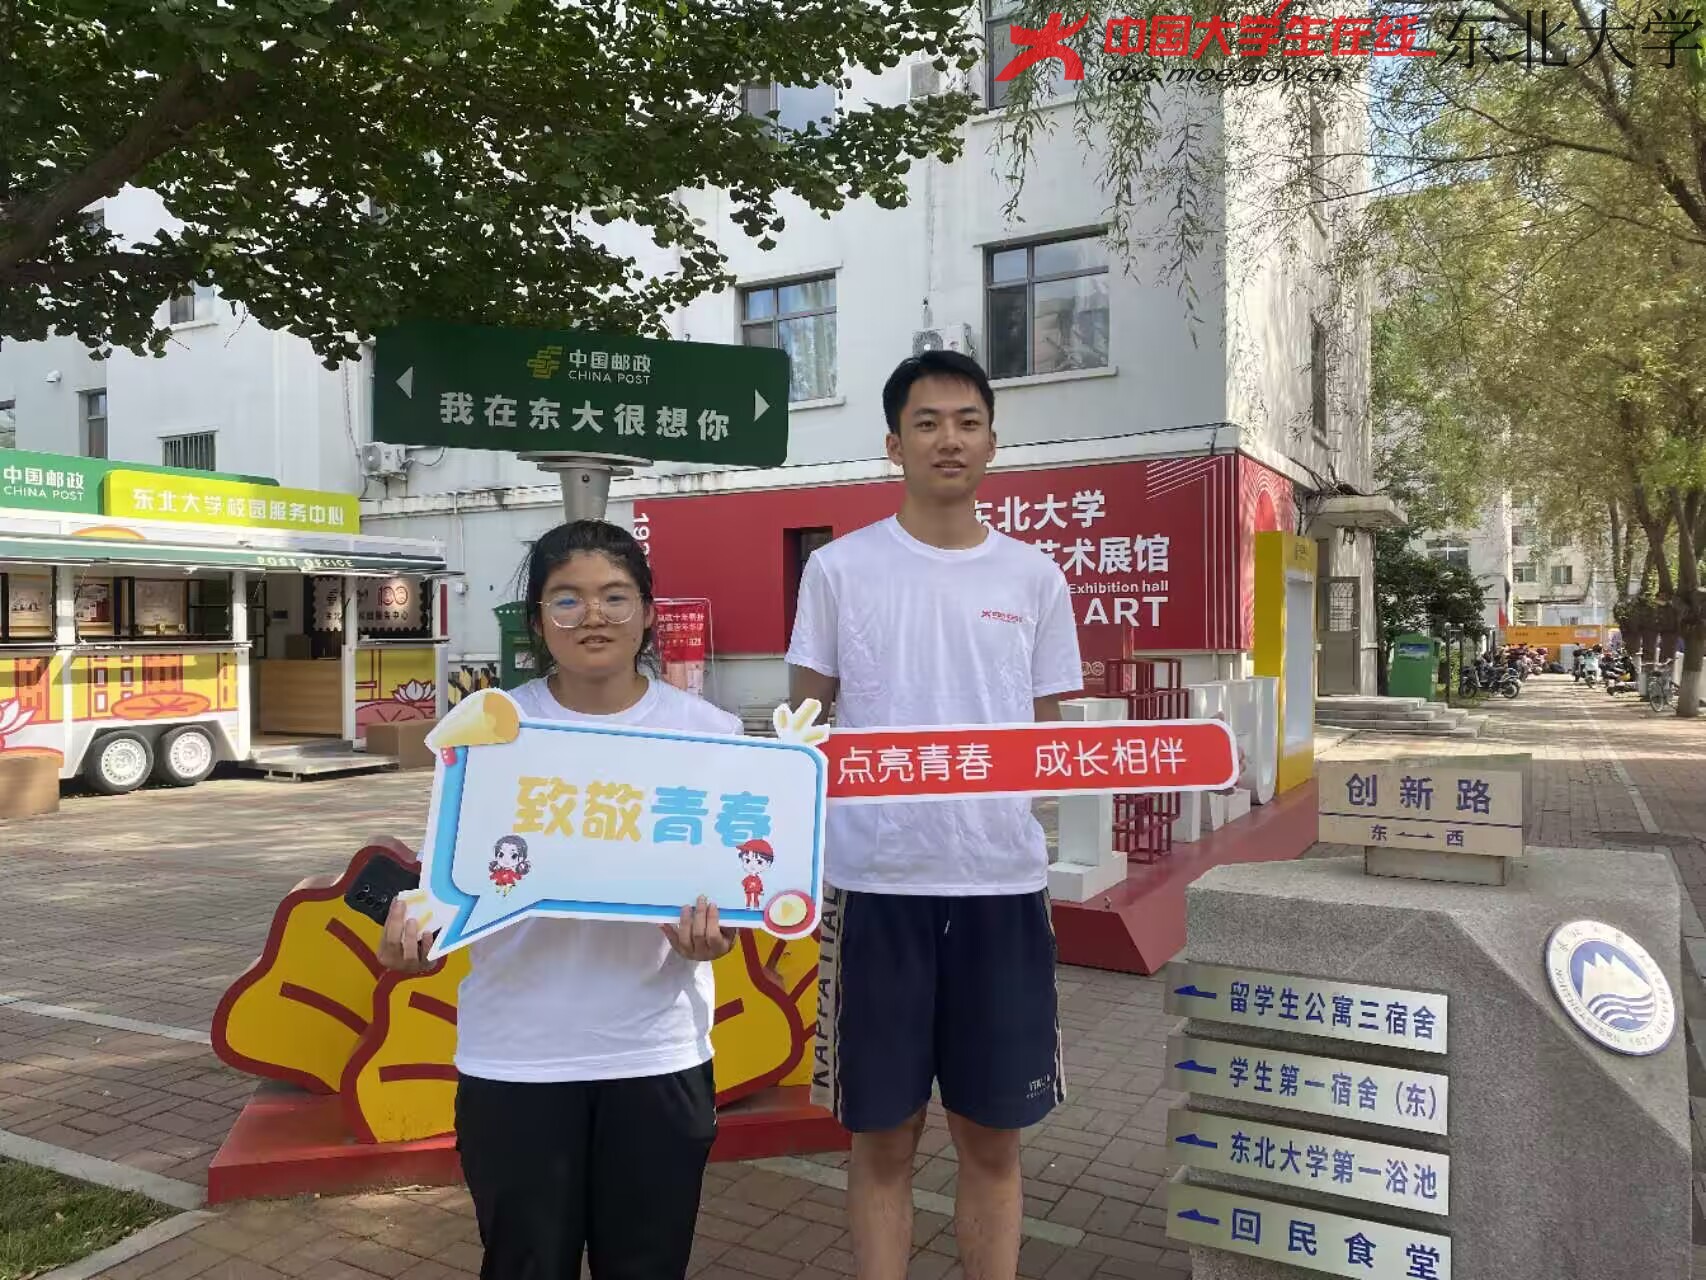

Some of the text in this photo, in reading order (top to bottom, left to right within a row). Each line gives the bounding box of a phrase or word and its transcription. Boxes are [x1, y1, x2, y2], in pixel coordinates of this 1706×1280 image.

[568, 370, 651, 385] CHINA POST
[569, 349, 651, 373] 中国邮政
[439, 391, 730, 442] 我在东大很想你
[3, 464, 84, 490] 中国邮政
[3, 485, 84, 502] CHINA POST
[131, 488, 344, 526] 东北大学校园服务中心
[1069, 580, 1169, 594] Exhibition hall
[1083, 596, 1169, 627] ART
[837, 737, 1187, 785] 点亮青春 成长相伴
[512, 775, 772, 848] 致敬青春
[1346, 773, 1492, 816] 创新路
[1369, 824, 1465, 848] 东 西
[1230, 981, 1437, 1041] 留学生公寓三宿舍
[1230, 1131, 1438, 1200] 东北大学第一浴池
[1231, 1207, 1440, 1280] 回民食堂
